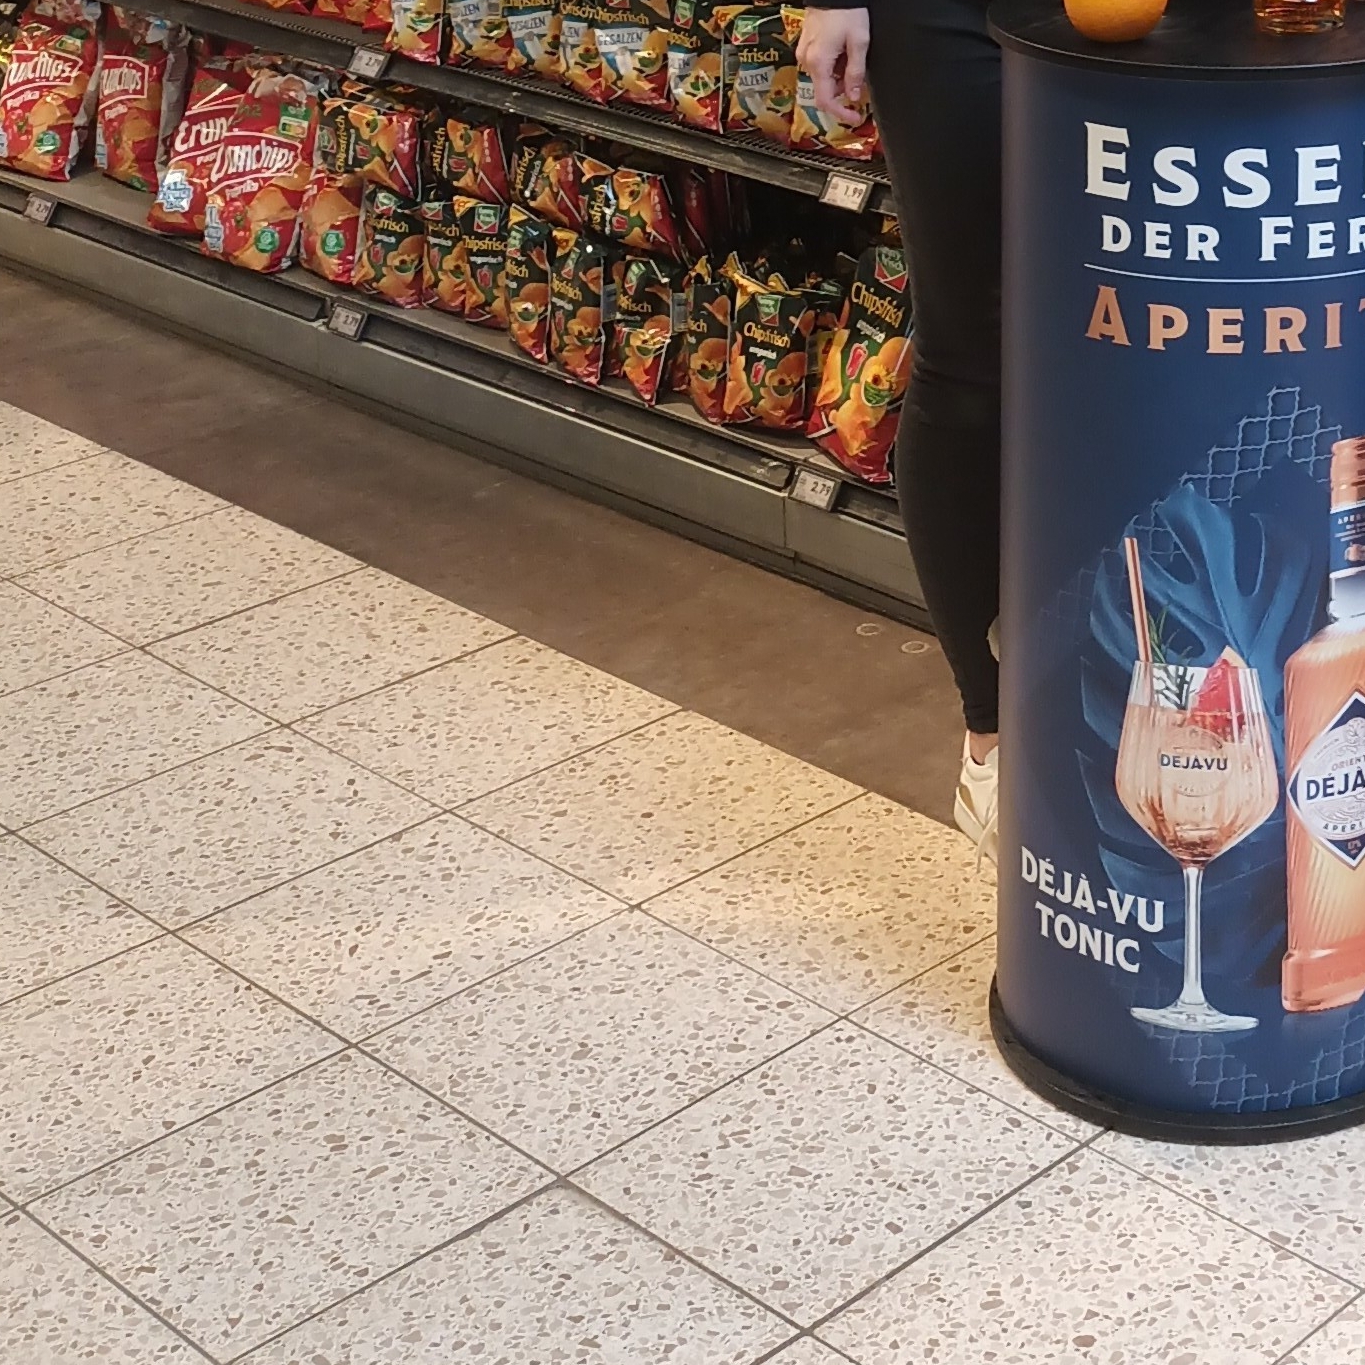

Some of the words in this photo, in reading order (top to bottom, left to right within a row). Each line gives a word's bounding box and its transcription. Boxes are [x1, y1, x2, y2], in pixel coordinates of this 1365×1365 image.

[598, 30, 645, 47] GESALZEN
[738, 47, 780, 64] sfrisch
[5, 50, 77, 85] runchips
[738, 72, 770, 88] ALZEN
[843, 185, 864, 199] 1.99
[1101, 214, 1221, 262] DER
[811, 480, 832, 497] 2.79
[1020, 845, 1165, 934] DÉJÀ-VU
[1034, 901, 1142, 974] TONIC
